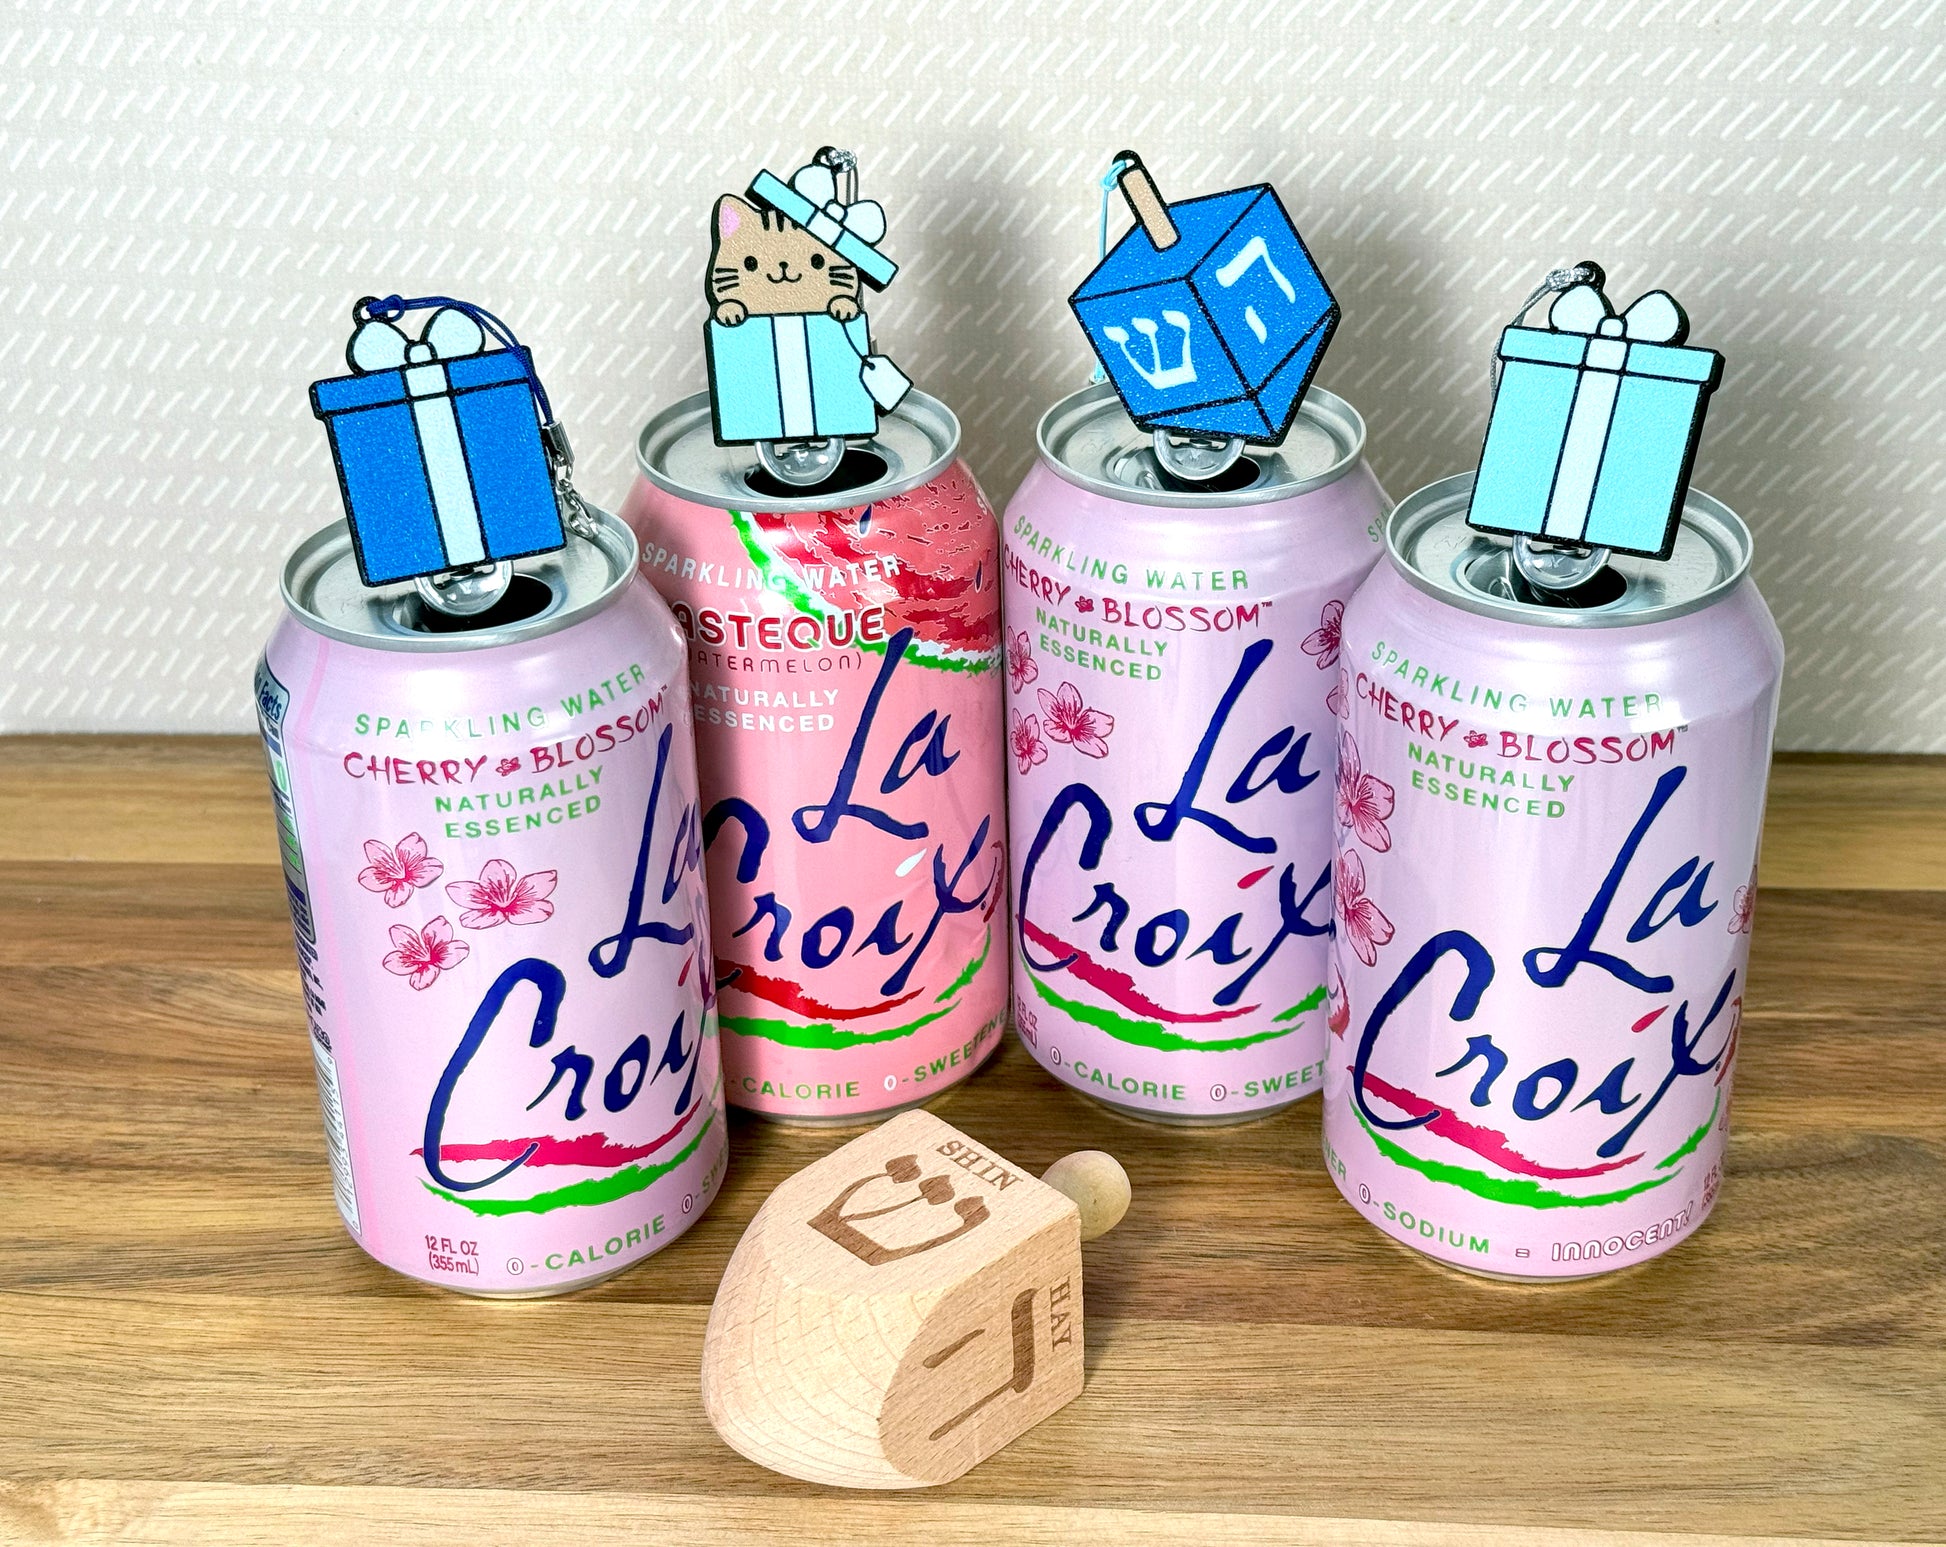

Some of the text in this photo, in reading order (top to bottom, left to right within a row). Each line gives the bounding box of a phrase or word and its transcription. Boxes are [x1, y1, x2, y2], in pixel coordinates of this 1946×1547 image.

[642, 541, 901, 591] SPARKLING WATER
[1004, 543, 1072, 606] CHERRY
[1013, 514, 1249, 591] SPARKLING WATER
[671, 600, 886, 651] ASTEQUE
[1035, 606, 1169, 658] NATURALLY
[688, 647, 863, 674] ATERMELON)
[1039, 633, 1163, 681] ESSENCED
[1370, 640, 1663, 719] SPARKLING WATER
[355, 662, 646, 739] SPARKLING WATER
[690, 681, 840, 709] NATURALLY
[693, 703, 835, 733] ESSENCED
[1355, 672, 1459, 743] CHERRY
[791, 627, 961, 844] La
[1133, 638, 1321, 854] La
[343, 751, 488, 786] CHERRY
[435, 765, 604, 813] NATURALLY
[1408, 741, 1575, 793] NATURALLY
[445, 795, 602, 839] ESSENCED
[1411, 771, 1566, 819] ESSENCED
[1018, 782, 1333, 1007] Croix
[1522, 765, 1719, 994] La
[1354, 930, 1737, 1158] Croix
[935, 1138, 1024, 1192] SHIN
[425, 1234, 479, 1256] 12 FL OZ
[1551, 1200, 1694, 1263] INNOCENT!
[1049, 1275, 1073, 1353] HAY
